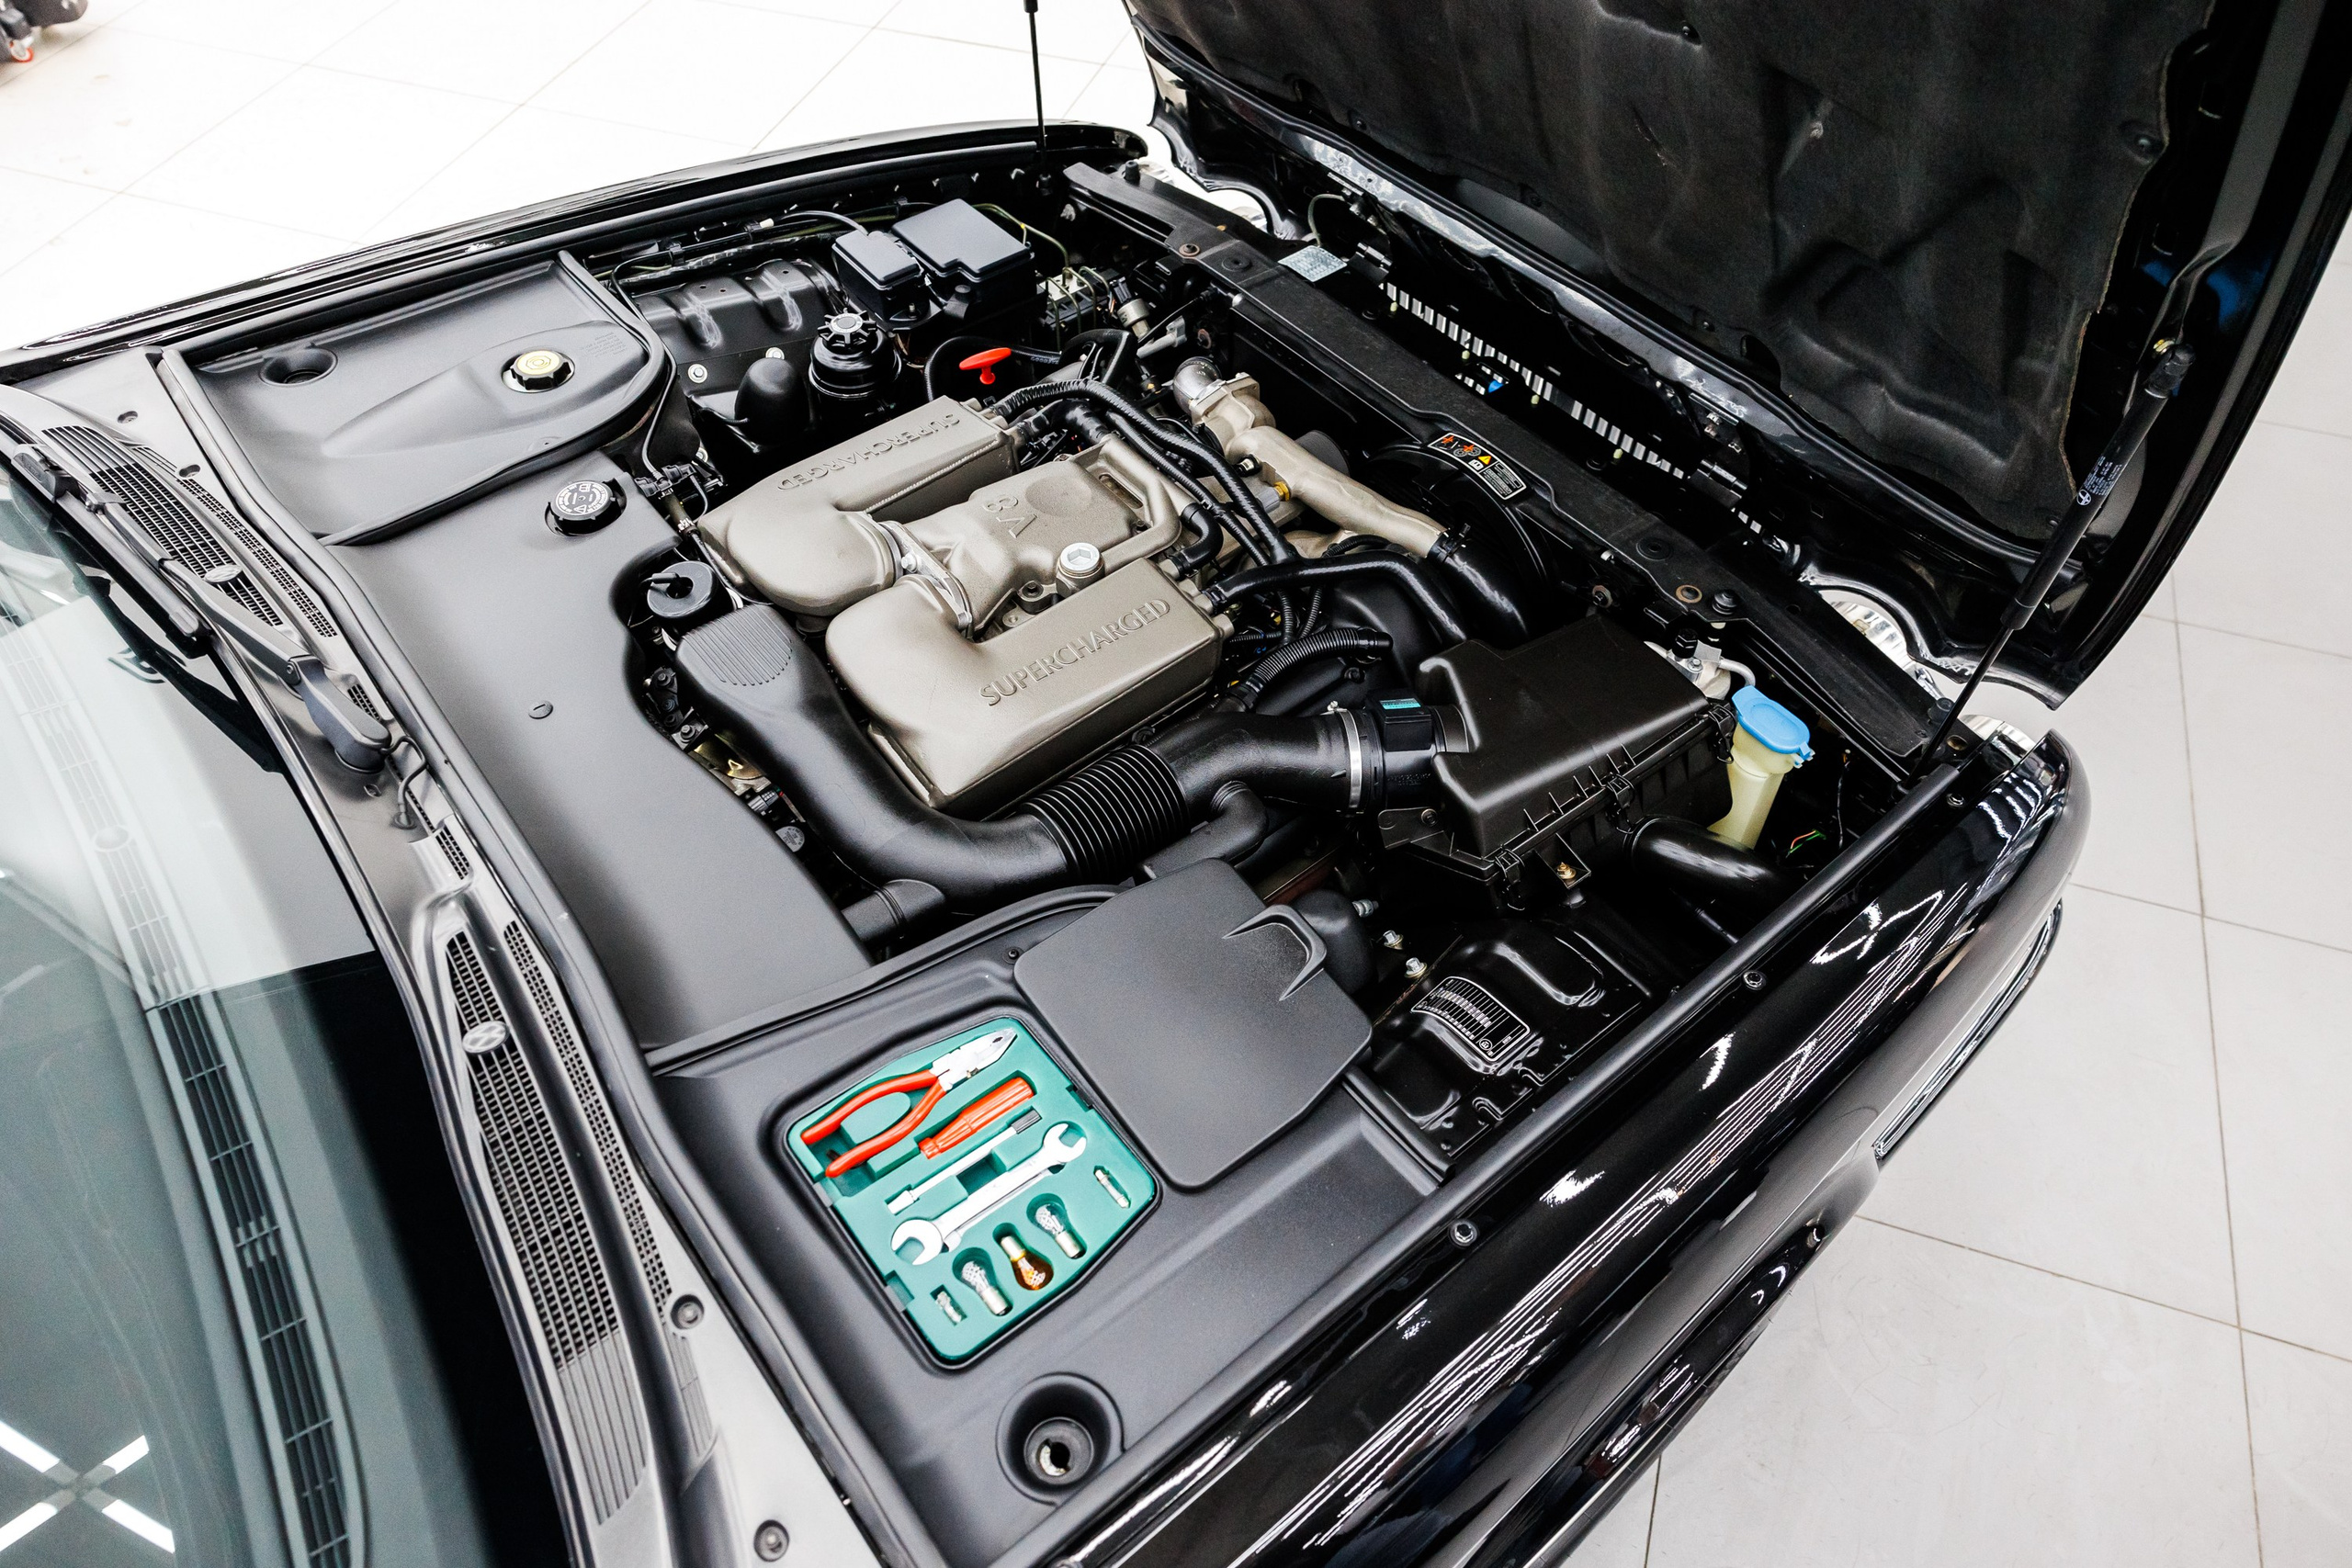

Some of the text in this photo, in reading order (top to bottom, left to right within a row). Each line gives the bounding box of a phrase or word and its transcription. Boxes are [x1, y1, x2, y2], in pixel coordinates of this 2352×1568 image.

[777, 413, 960, 491] SUPERCHARGED
[981, 495, 1037, 538] V8
[979, 598, 1170, 706] SUPERCHARGED
